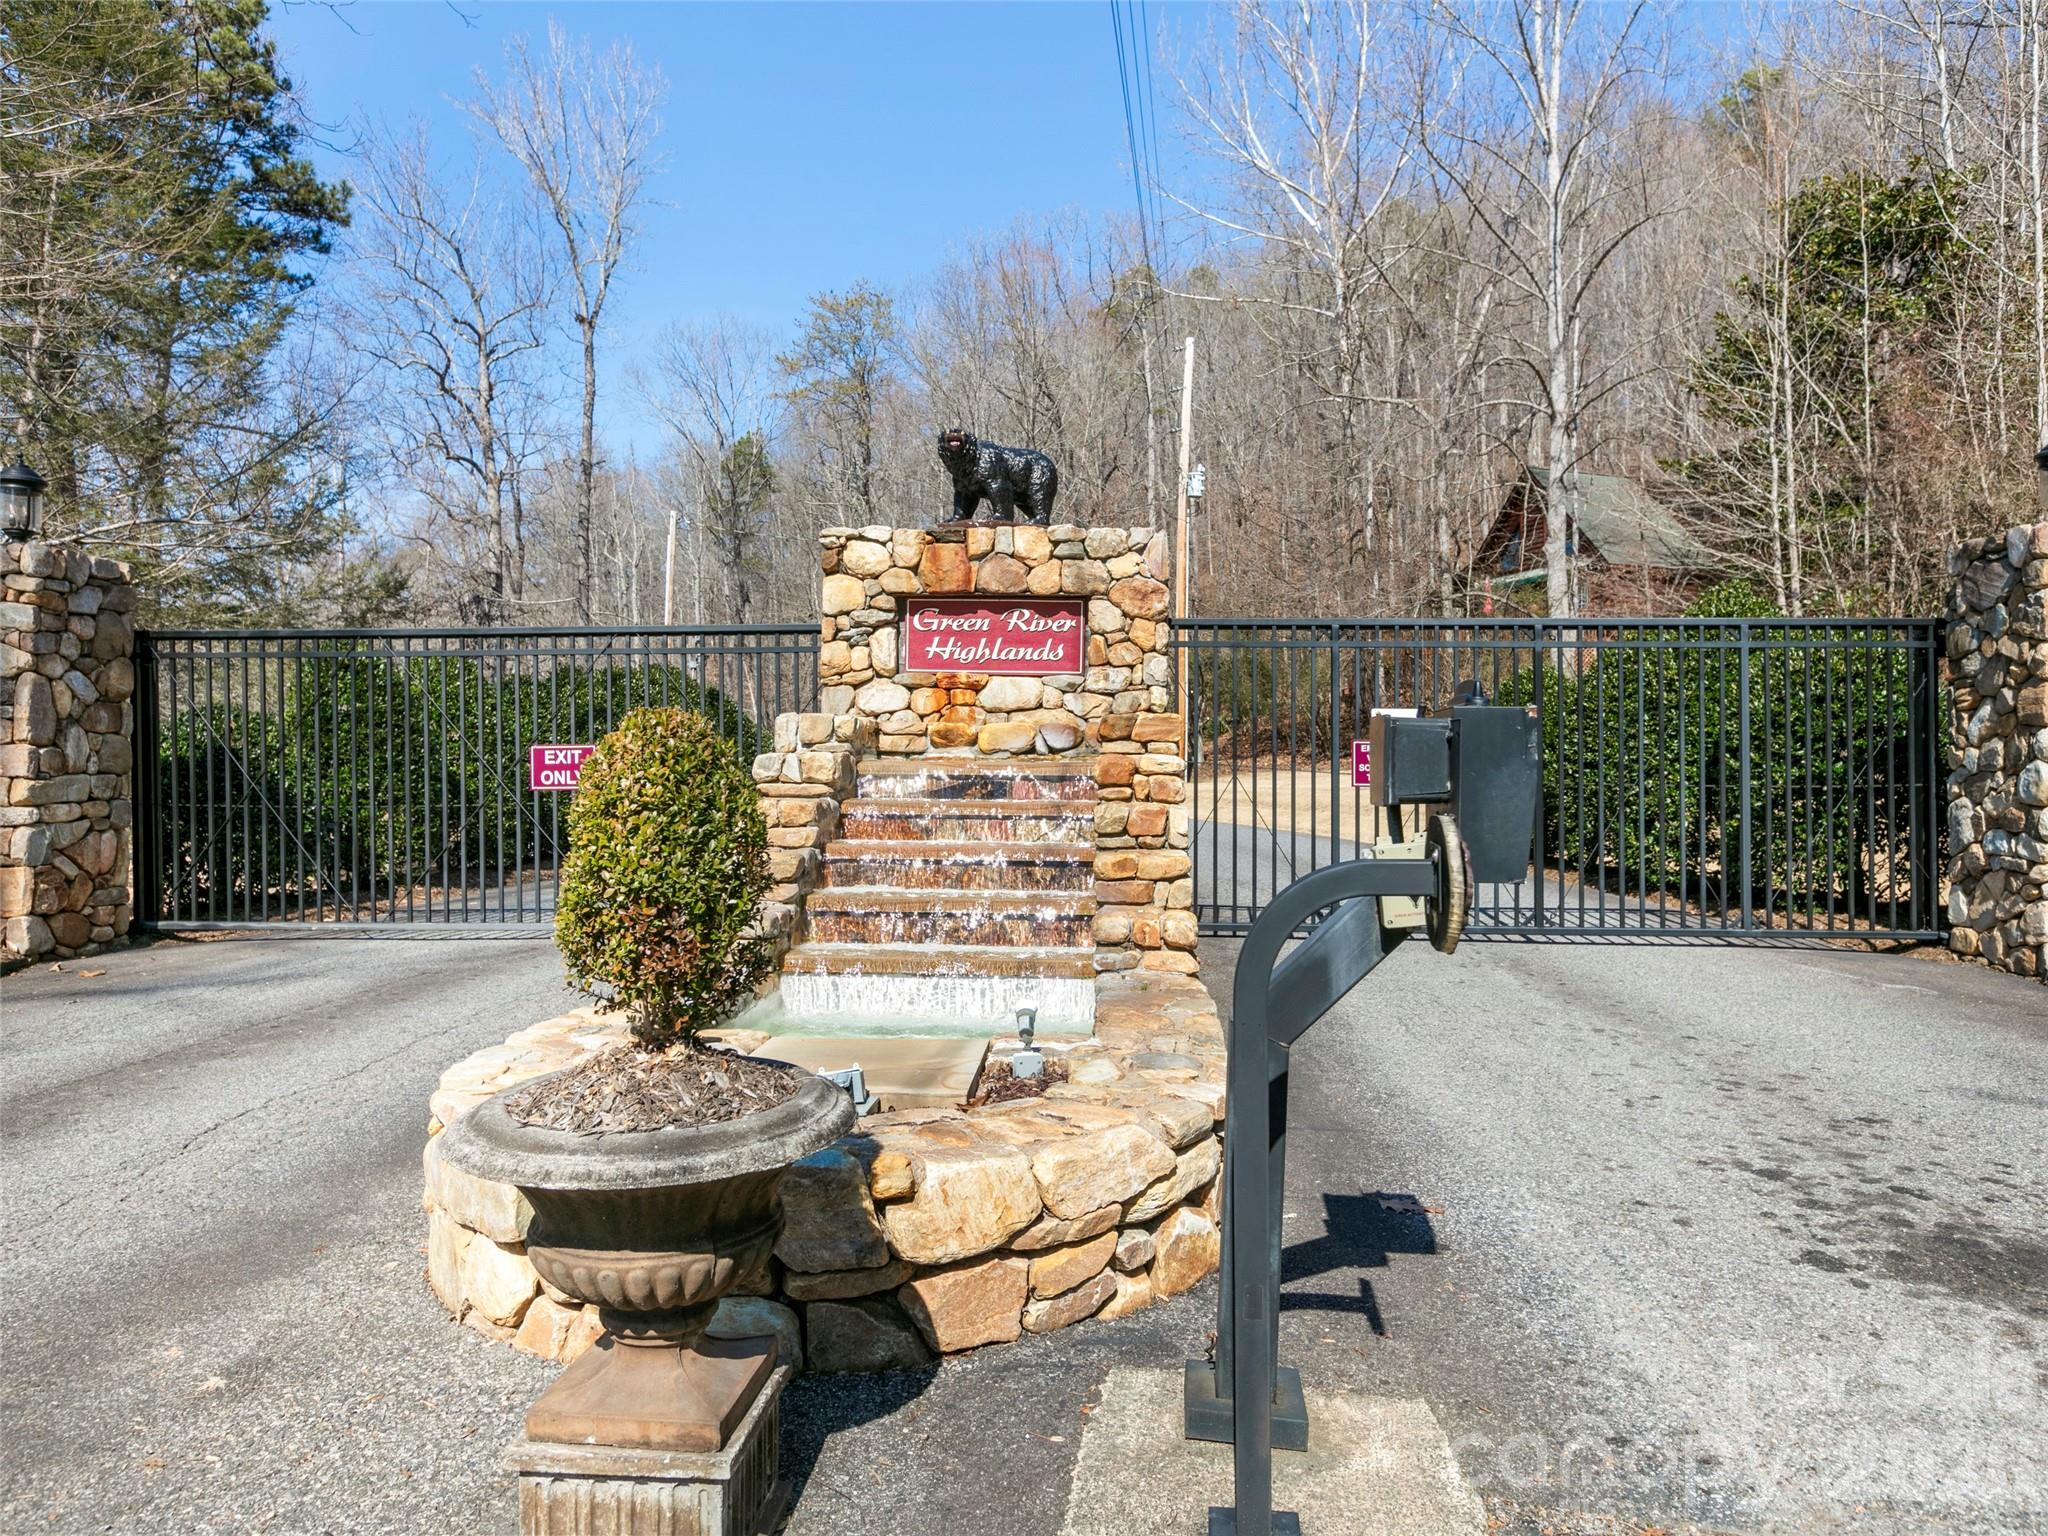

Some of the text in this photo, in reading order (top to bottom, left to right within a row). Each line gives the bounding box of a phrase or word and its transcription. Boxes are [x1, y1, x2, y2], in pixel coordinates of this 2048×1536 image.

[912, 608, 1077, 633] Green River
[925, 636, 1065, 664] Highlands
[544, 750, 582, 765] EXIT
